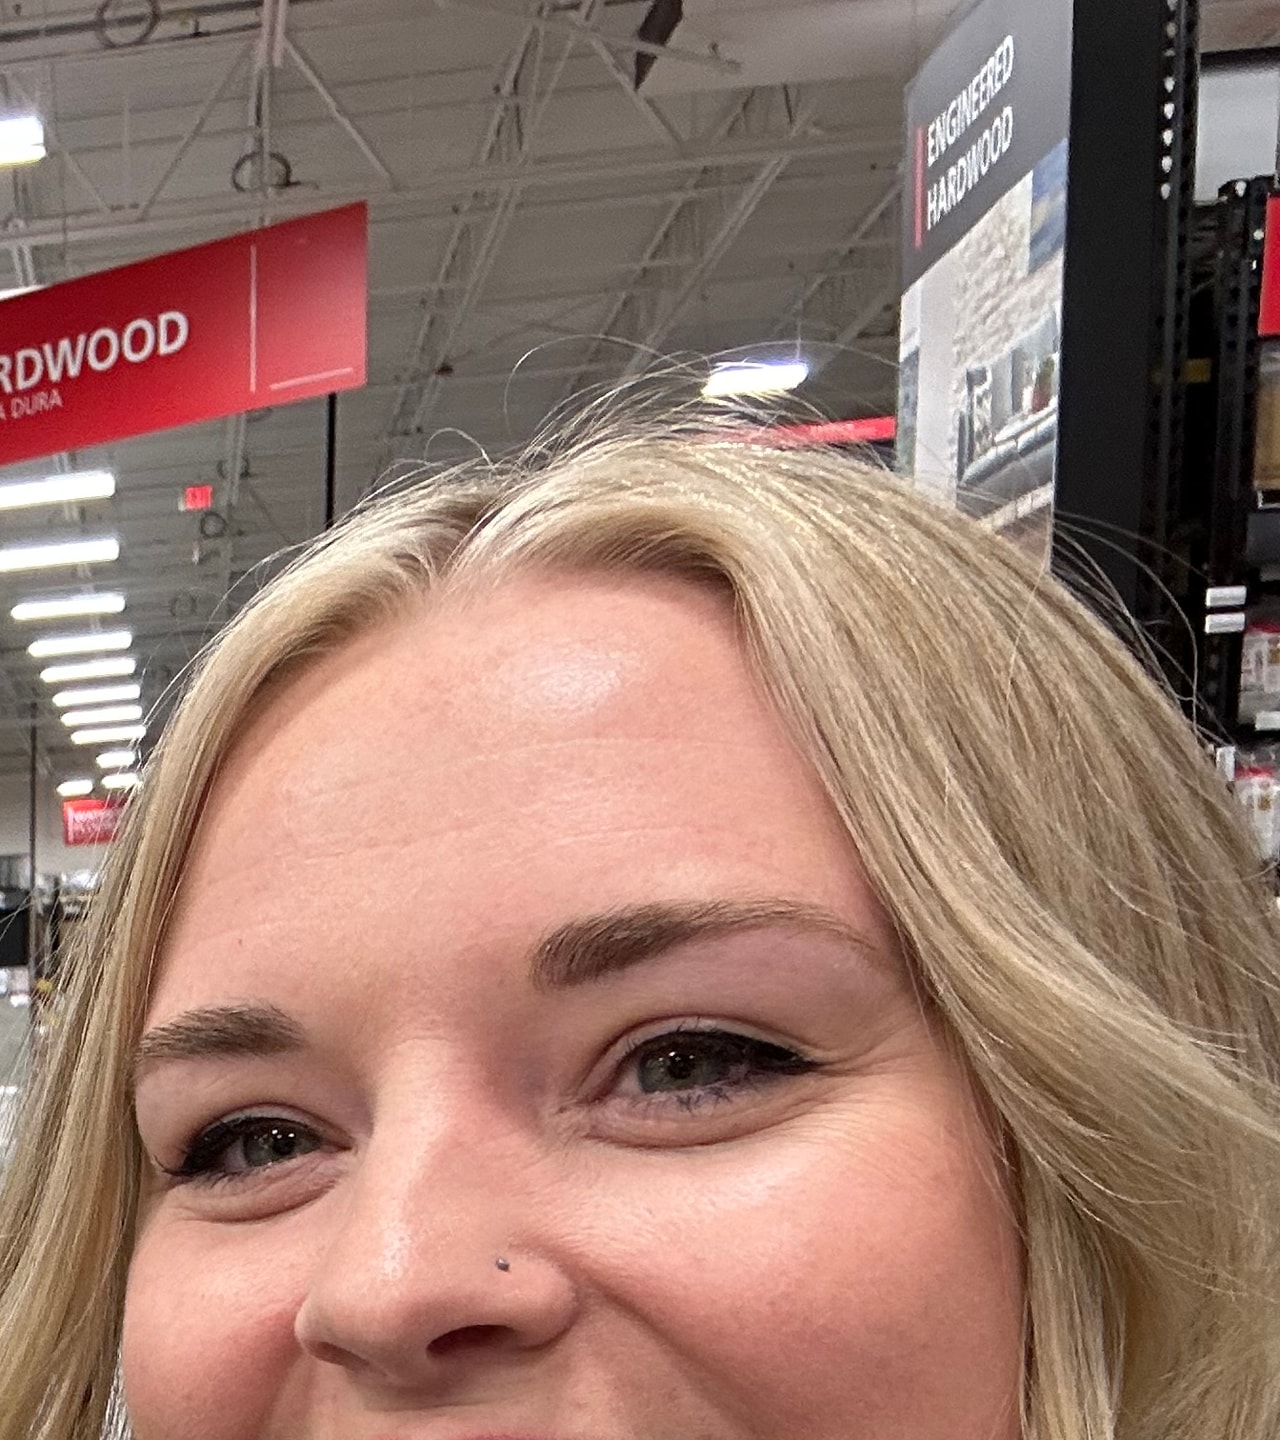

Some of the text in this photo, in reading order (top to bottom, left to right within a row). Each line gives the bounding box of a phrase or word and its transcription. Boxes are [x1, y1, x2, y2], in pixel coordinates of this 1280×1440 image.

[928, 35, 1014, 167] ENGINEERED
[928, 106, 1013, 230] HARDWOOD
[10, 389, 63, 419] DURA
